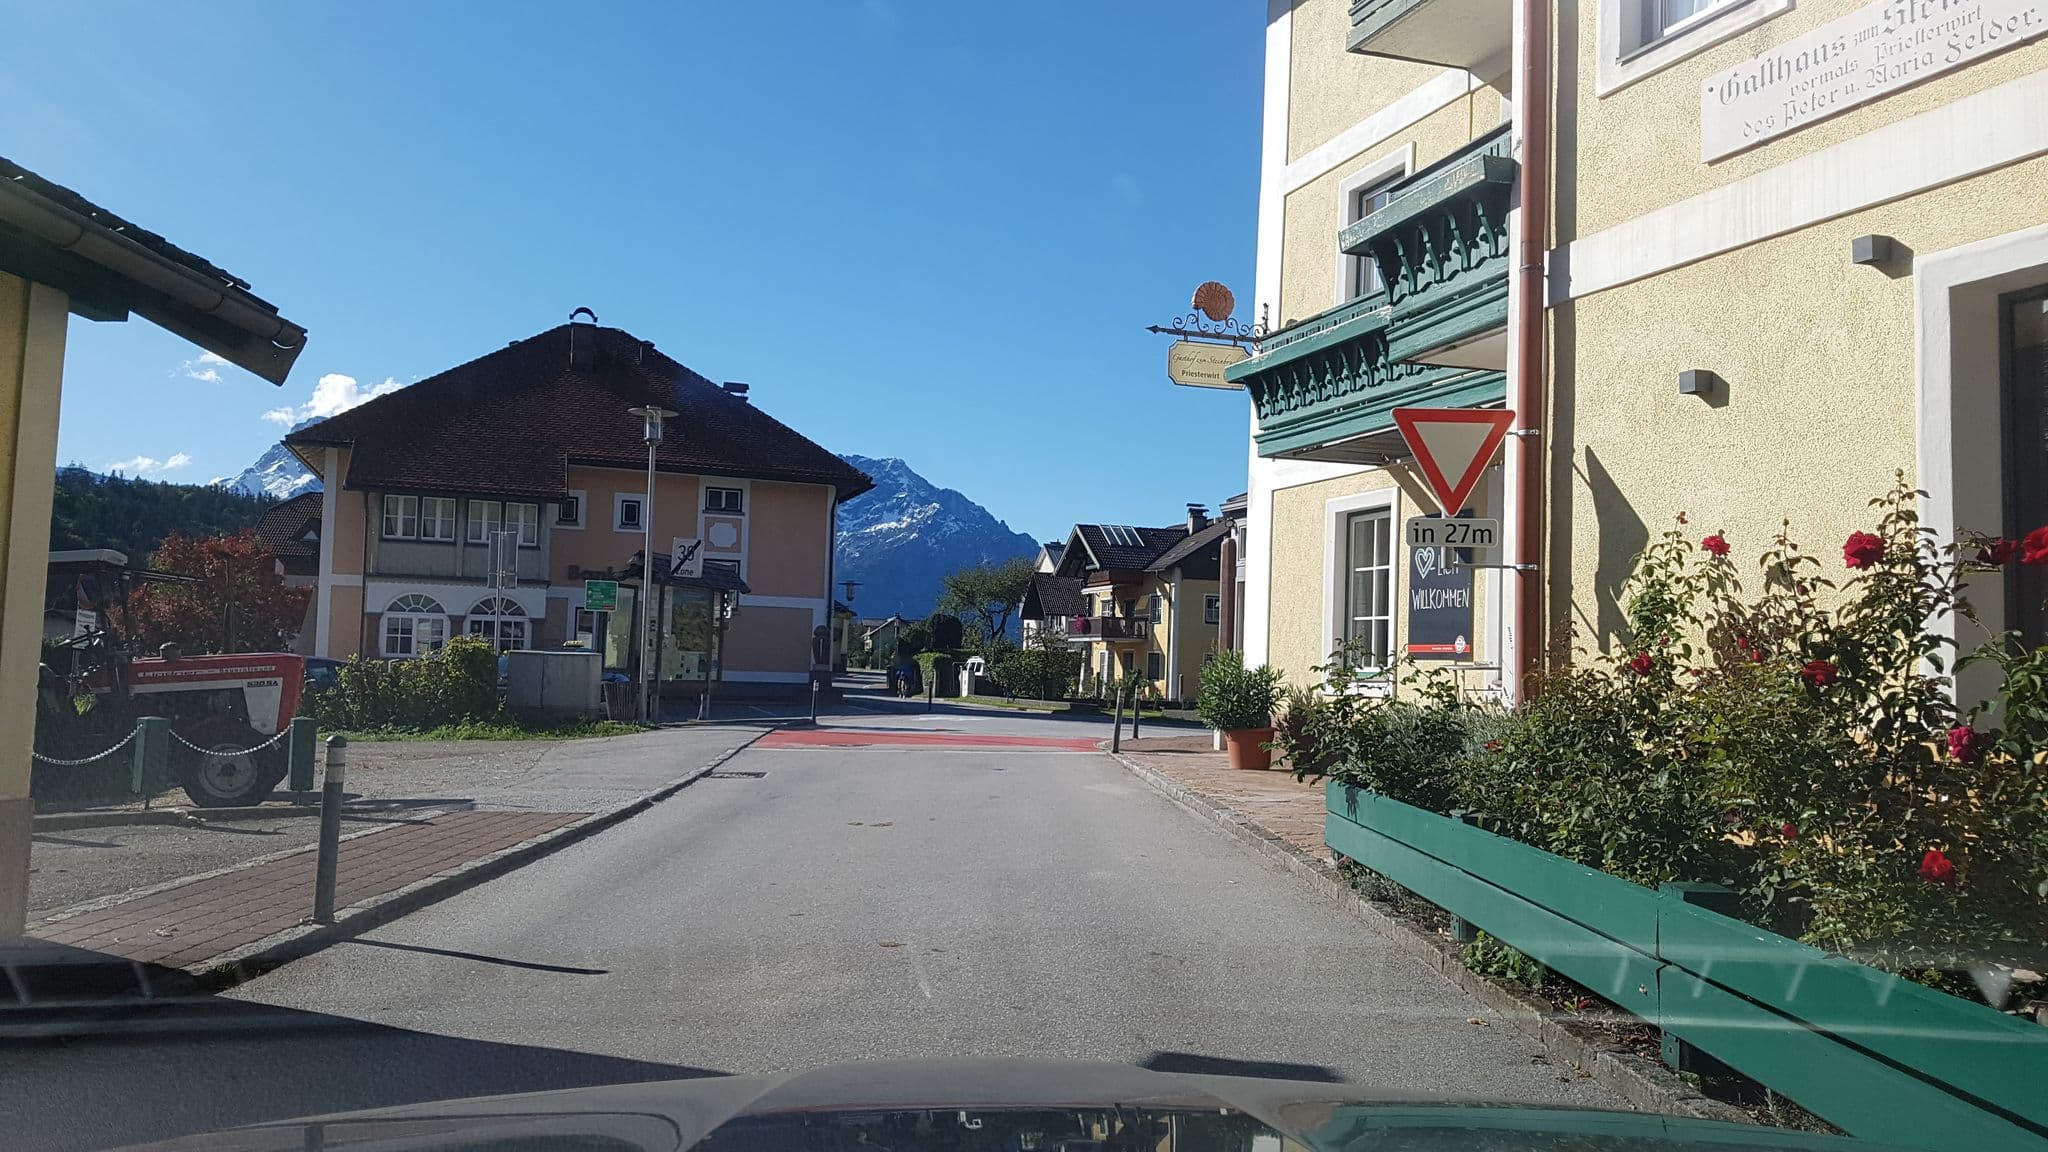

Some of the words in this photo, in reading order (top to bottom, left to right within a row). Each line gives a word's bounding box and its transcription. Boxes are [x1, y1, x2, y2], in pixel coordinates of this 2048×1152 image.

[1789, 58, 1859, 97] vormals
[1181, 369, 1220, 380] Priesterwirt
[1412, 521, 1435, 544] in
[1444, 523, 1493, 544] 27m
[1411, 586, 1471, 611] WILLKOMMEN
